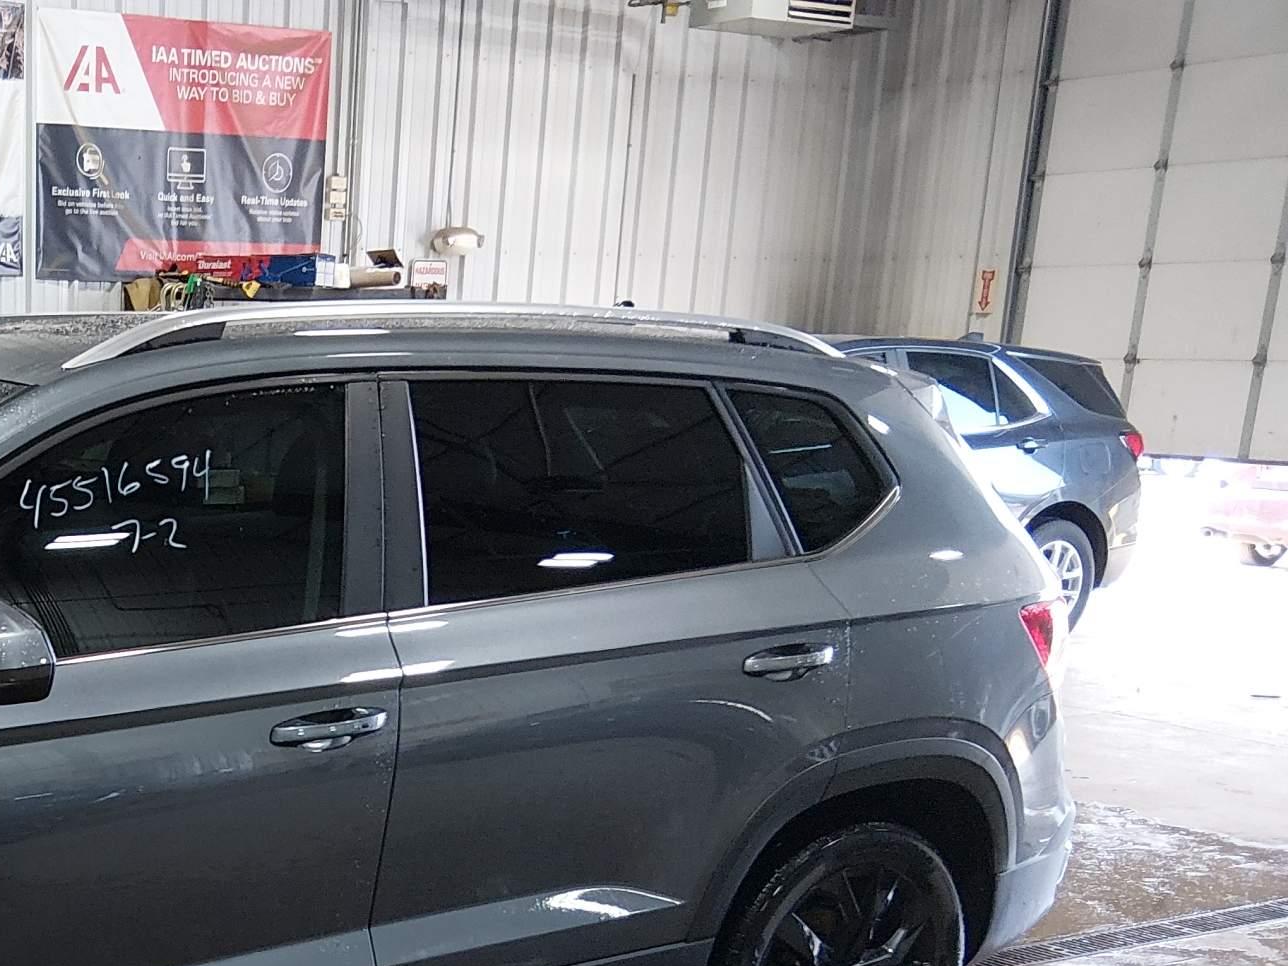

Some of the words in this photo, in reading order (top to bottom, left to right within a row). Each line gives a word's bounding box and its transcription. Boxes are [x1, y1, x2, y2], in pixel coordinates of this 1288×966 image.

[151, 45, 179, 65] IAA
[181, 48, 232, 68] TIMED
[169, 67, 259, 87] INTRODUCING
[262, 74, 272, 88] A
[274, 76, 306, 91] NEW
[176, 84, 207, 102] WAY
[210, 87, 229, 102] TO
[232, 89, 252, 104] BID
[255, 91, 267, 105] &
[269, 92, 297, 107] BUY
[51, 186, 91, 198] Exclusive
[157, 191, 178, 202] Quick
[179, 193, 195, 203] and
[196, 194, 215, 205] Easy
[240, 195, 279, 207] Real-Time
[280, 196, 309, 208] Updates
[140, 250, 158, 261] Visit
[198, 259, 232, 270] Duralast
[19, 449, 212, 529] 45516594
[111, 517, 188, 554] 7-2
